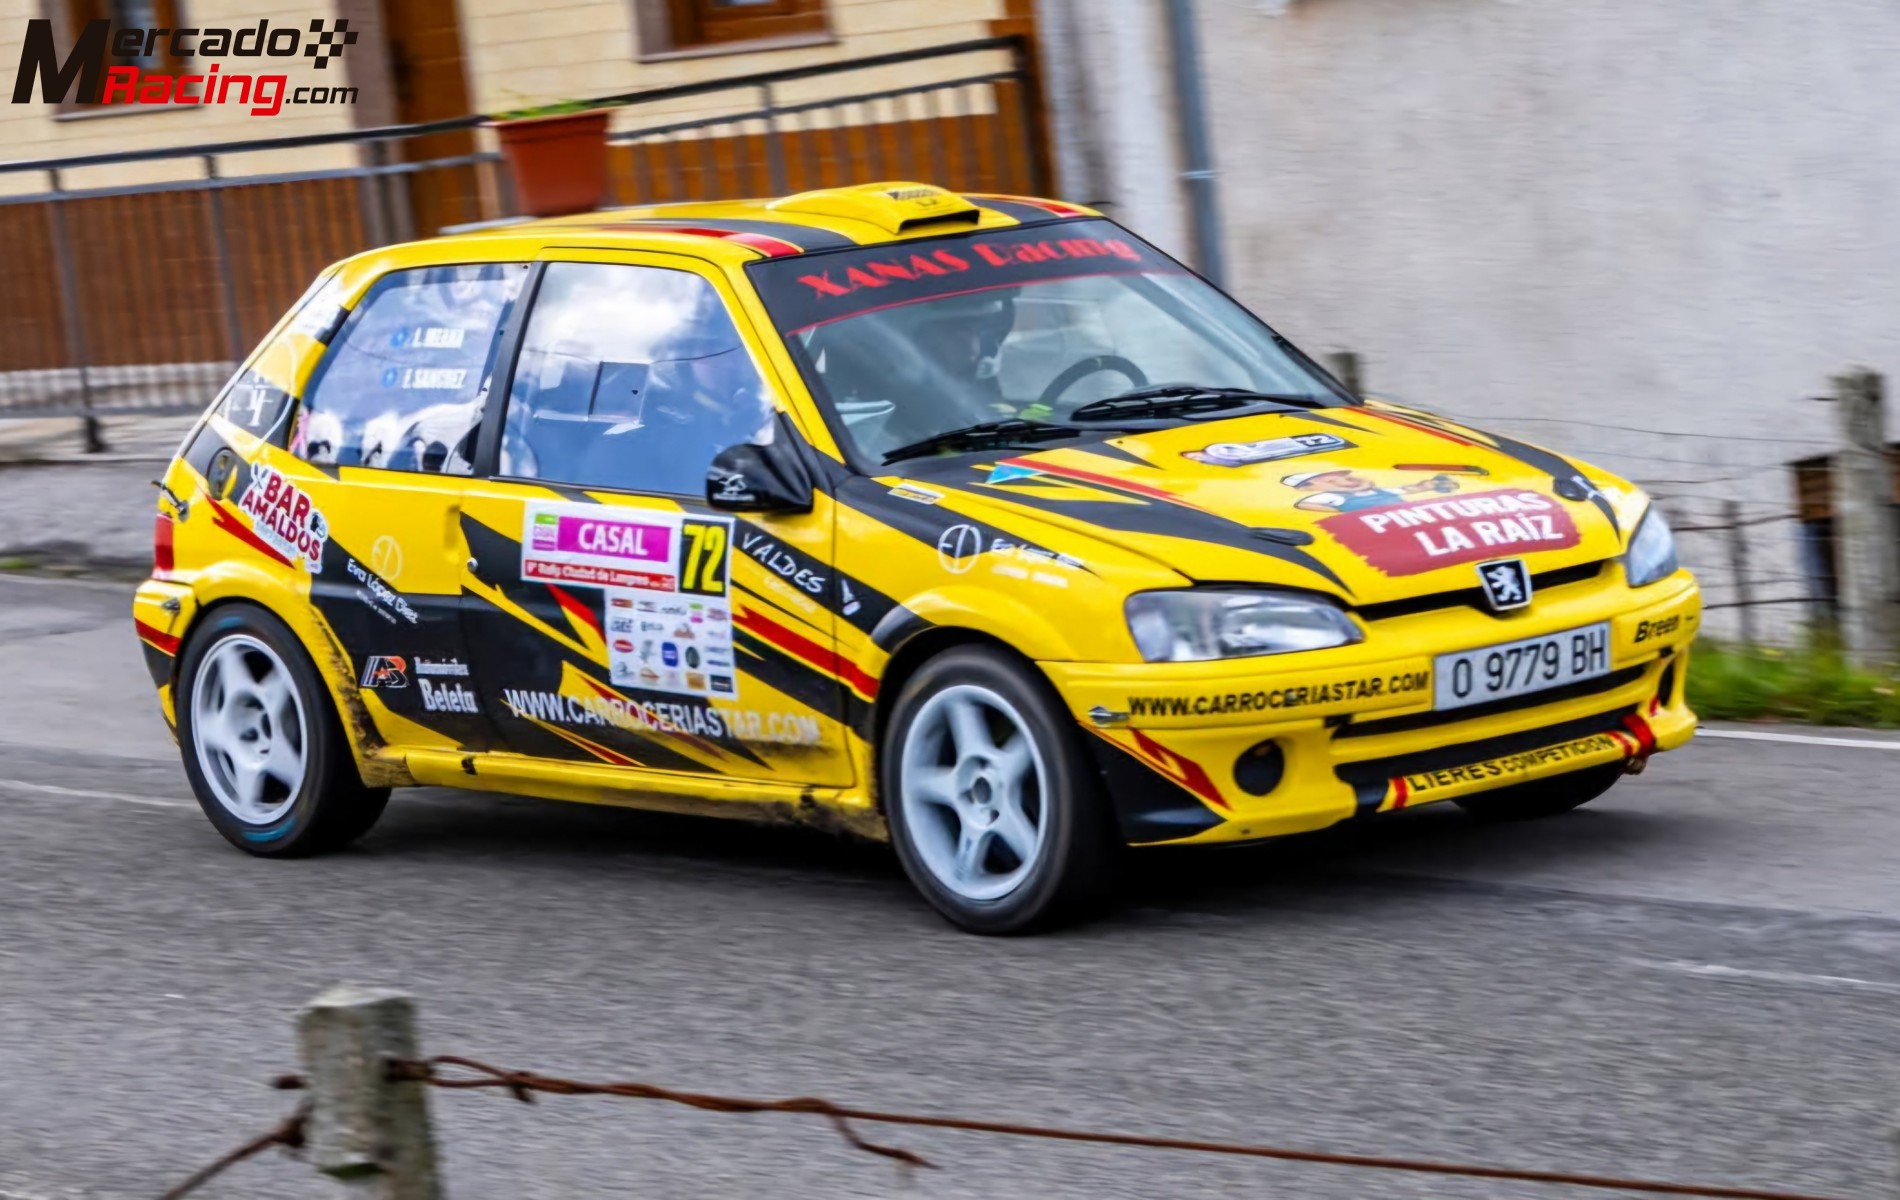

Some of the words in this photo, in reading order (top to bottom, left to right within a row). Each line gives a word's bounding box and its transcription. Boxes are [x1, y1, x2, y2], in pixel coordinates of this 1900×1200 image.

[797, 248, 970, 300] XANAS
[974, 238, 1142, 266] Racing
[242, 490, 320, 561] AMALDOS
[264, 472, 310, 528] BAR
[1359, 491, 1551, 534] PINTURAS
[578, 523, 648, 556] CASAL
[683, 524, 725, 592] 72
[742, 532, 827, 593] VALDES
[1416, 523, 1474, 556] LA
[1472, 512, 1564, 547] RAÍZ
[1485, 641, 1559, 692] 9779
[1572, 628, 1607, 674] BH
[504, 688, 820, 745] WWW.CARROCERIASTAR.COM
[1128, 672, 1429, 717] WWW.CARROCERIASTAR.COM
